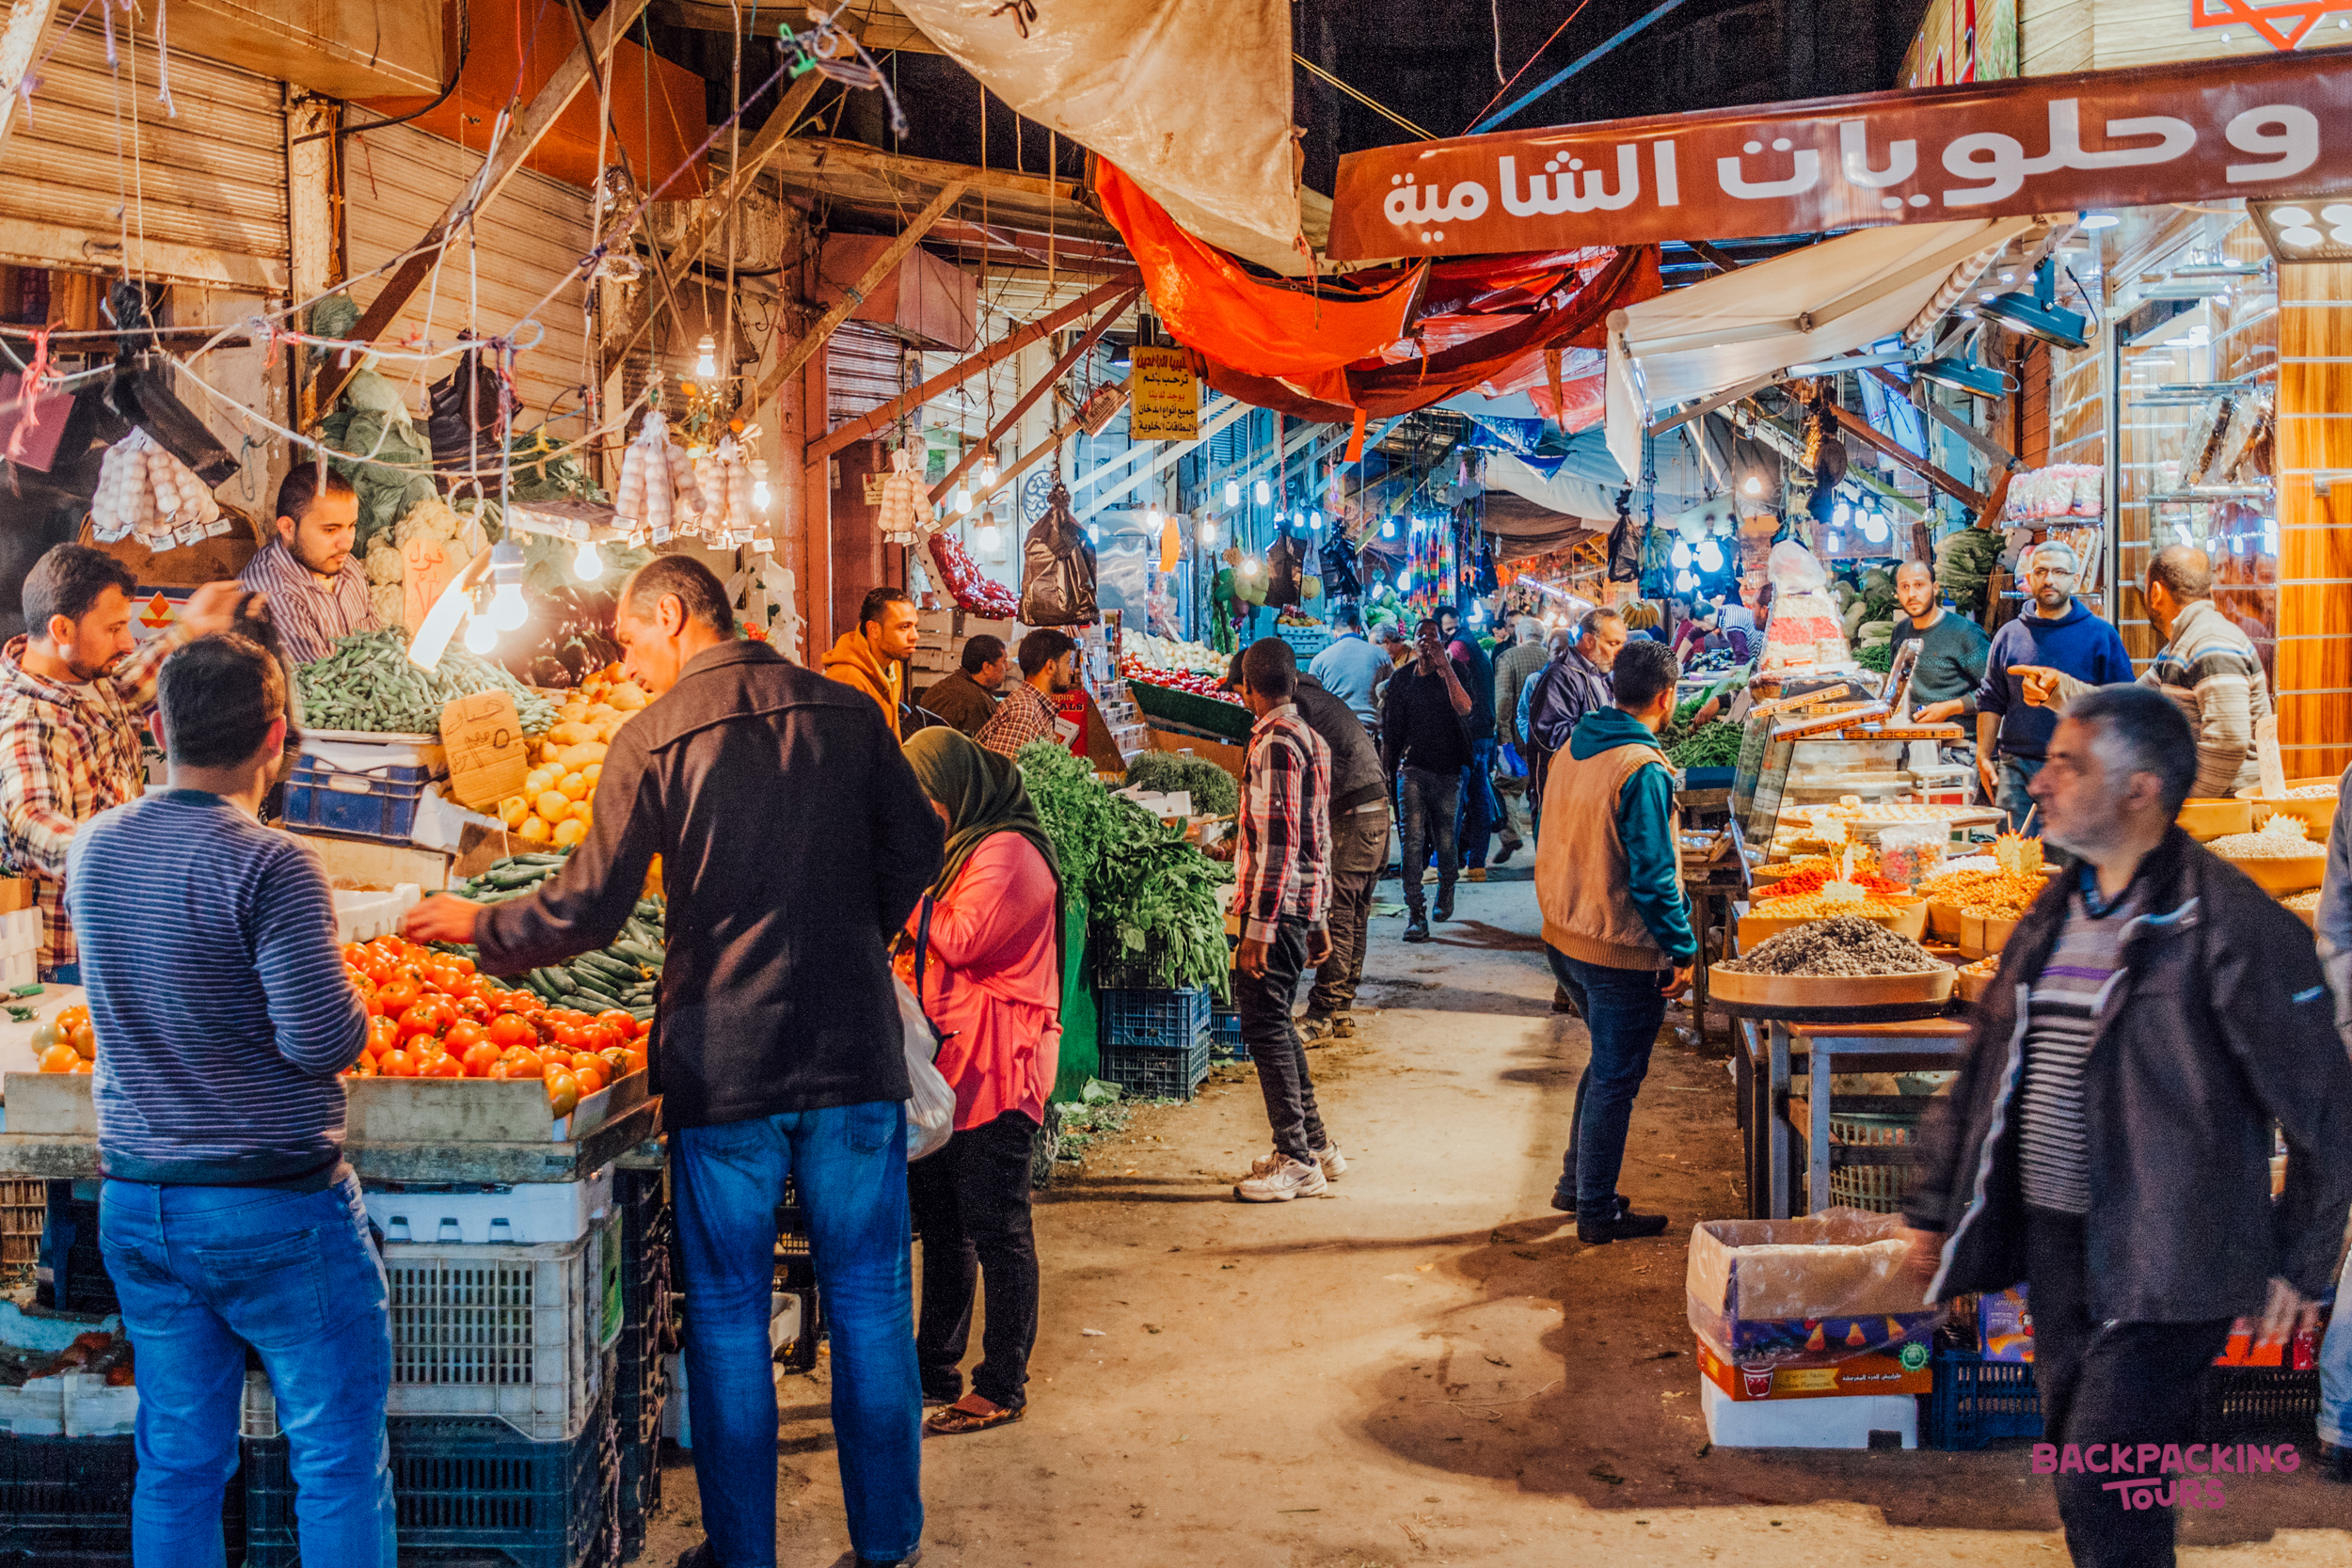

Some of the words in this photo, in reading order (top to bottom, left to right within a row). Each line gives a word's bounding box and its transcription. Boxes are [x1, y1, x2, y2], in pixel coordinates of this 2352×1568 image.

[1716, 98, 2319, 210] وحلويات
[1383, 139, 1679, 244] الشامية
[1162, 374, 1188, 387] ترحب
[1178, 408, 1195, 419] جميع
[409, 542, 444, 571] فول
[1059, 703, 1084, 712] ALS
